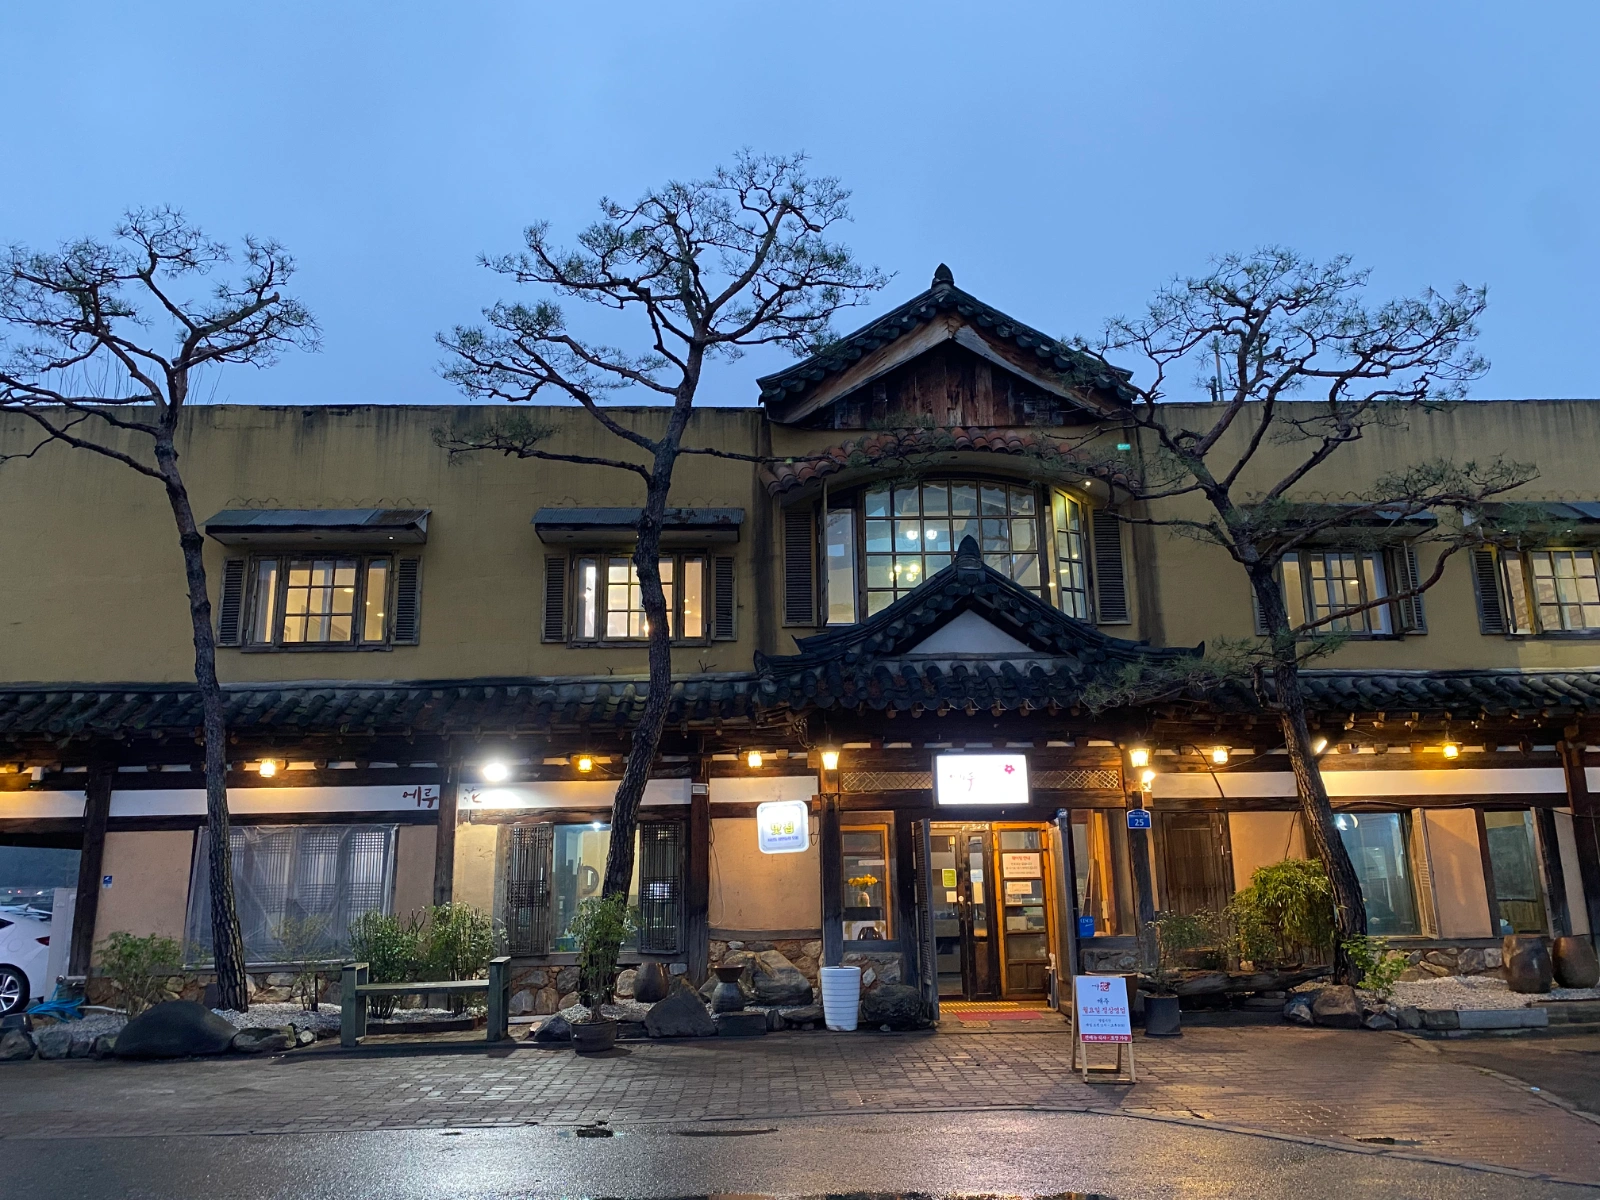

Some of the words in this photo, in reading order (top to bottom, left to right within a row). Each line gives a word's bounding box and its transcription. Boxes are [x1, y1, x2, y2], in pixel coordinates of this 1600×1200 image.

[1134, 818, 1145, 827] 25
[770, 821, 795, 836] 맛집
[1082, 1006, 1101, 1015] 월요일
[1102, 1006, 1126, 1015] 정상영업
